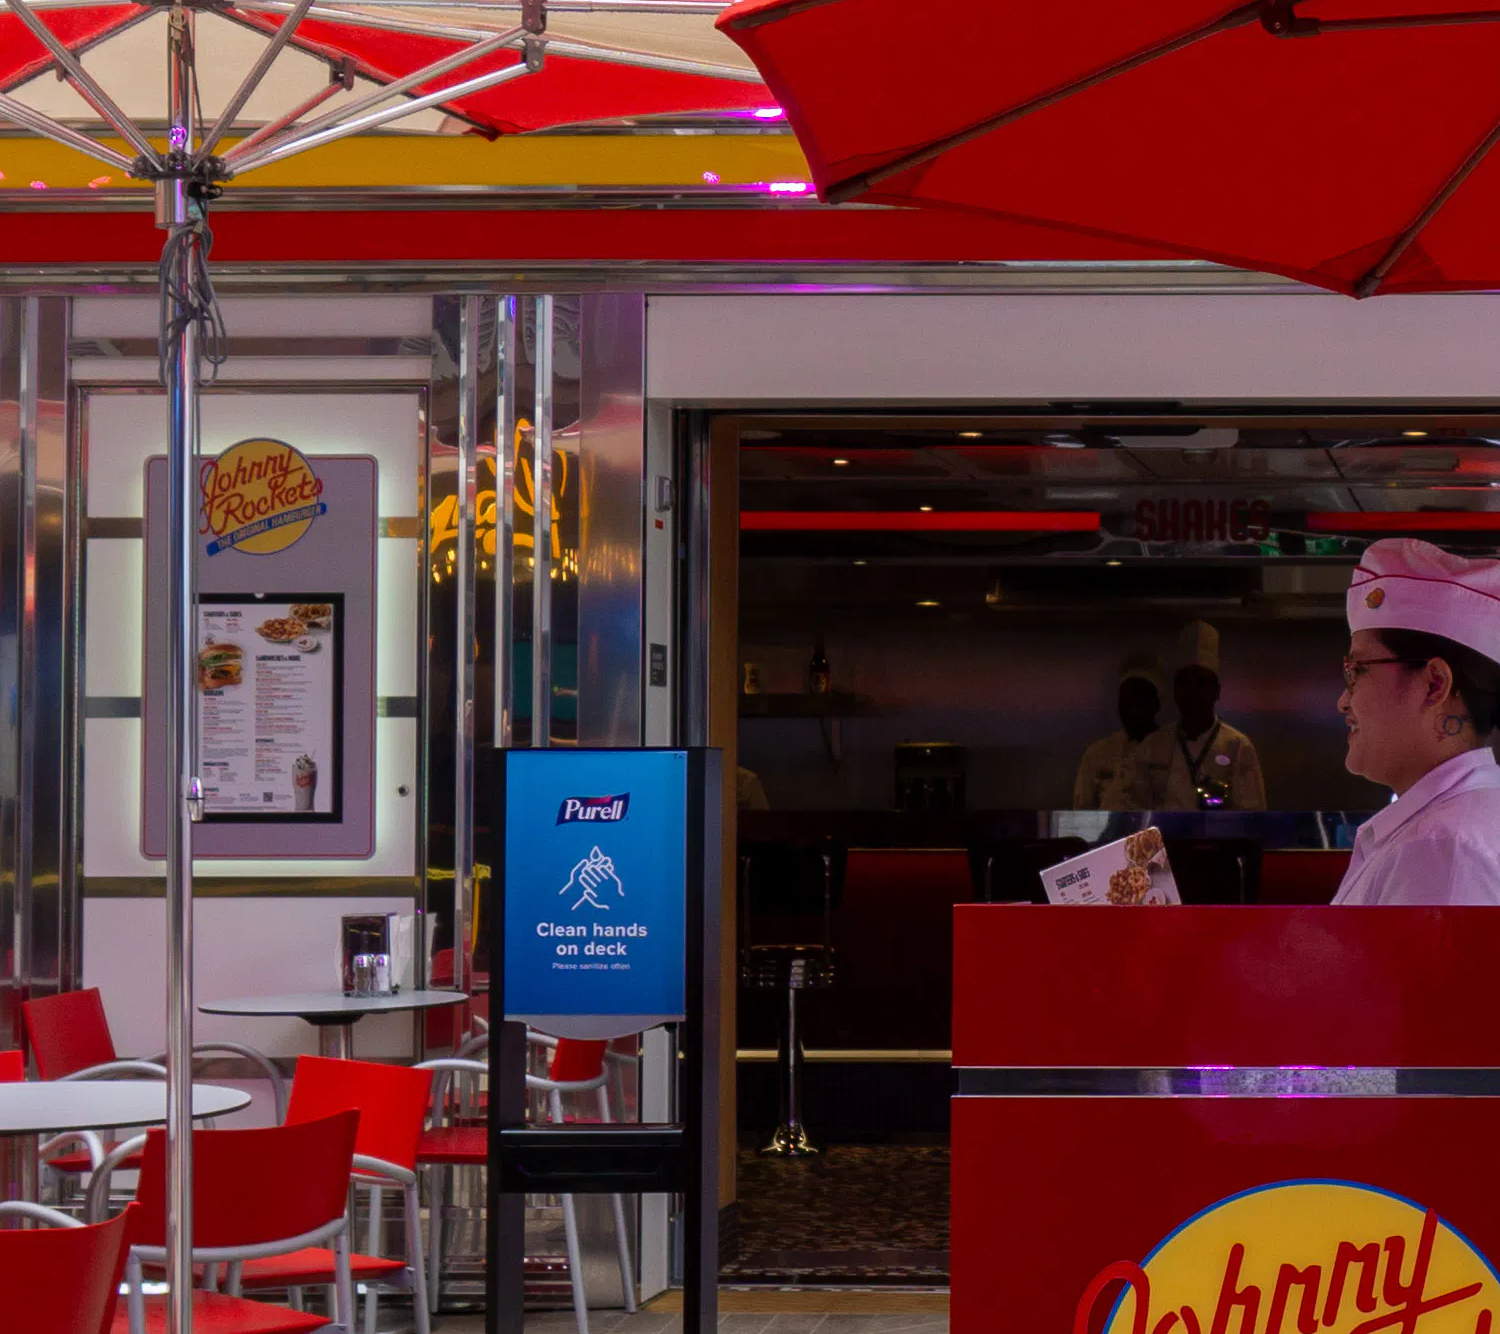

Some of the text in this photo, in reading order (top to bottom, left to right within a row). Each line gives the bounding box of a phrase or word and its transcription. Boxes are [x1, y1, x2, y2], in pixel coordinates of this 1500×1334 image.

[199, 448, 305, 535] Johnny
[212, 473, 324, 535] Rockets
[564, 799, 624, 820] Purell
[536, 922, 649, 937] Clean hands
[556, 942, 628, 956] on deck
